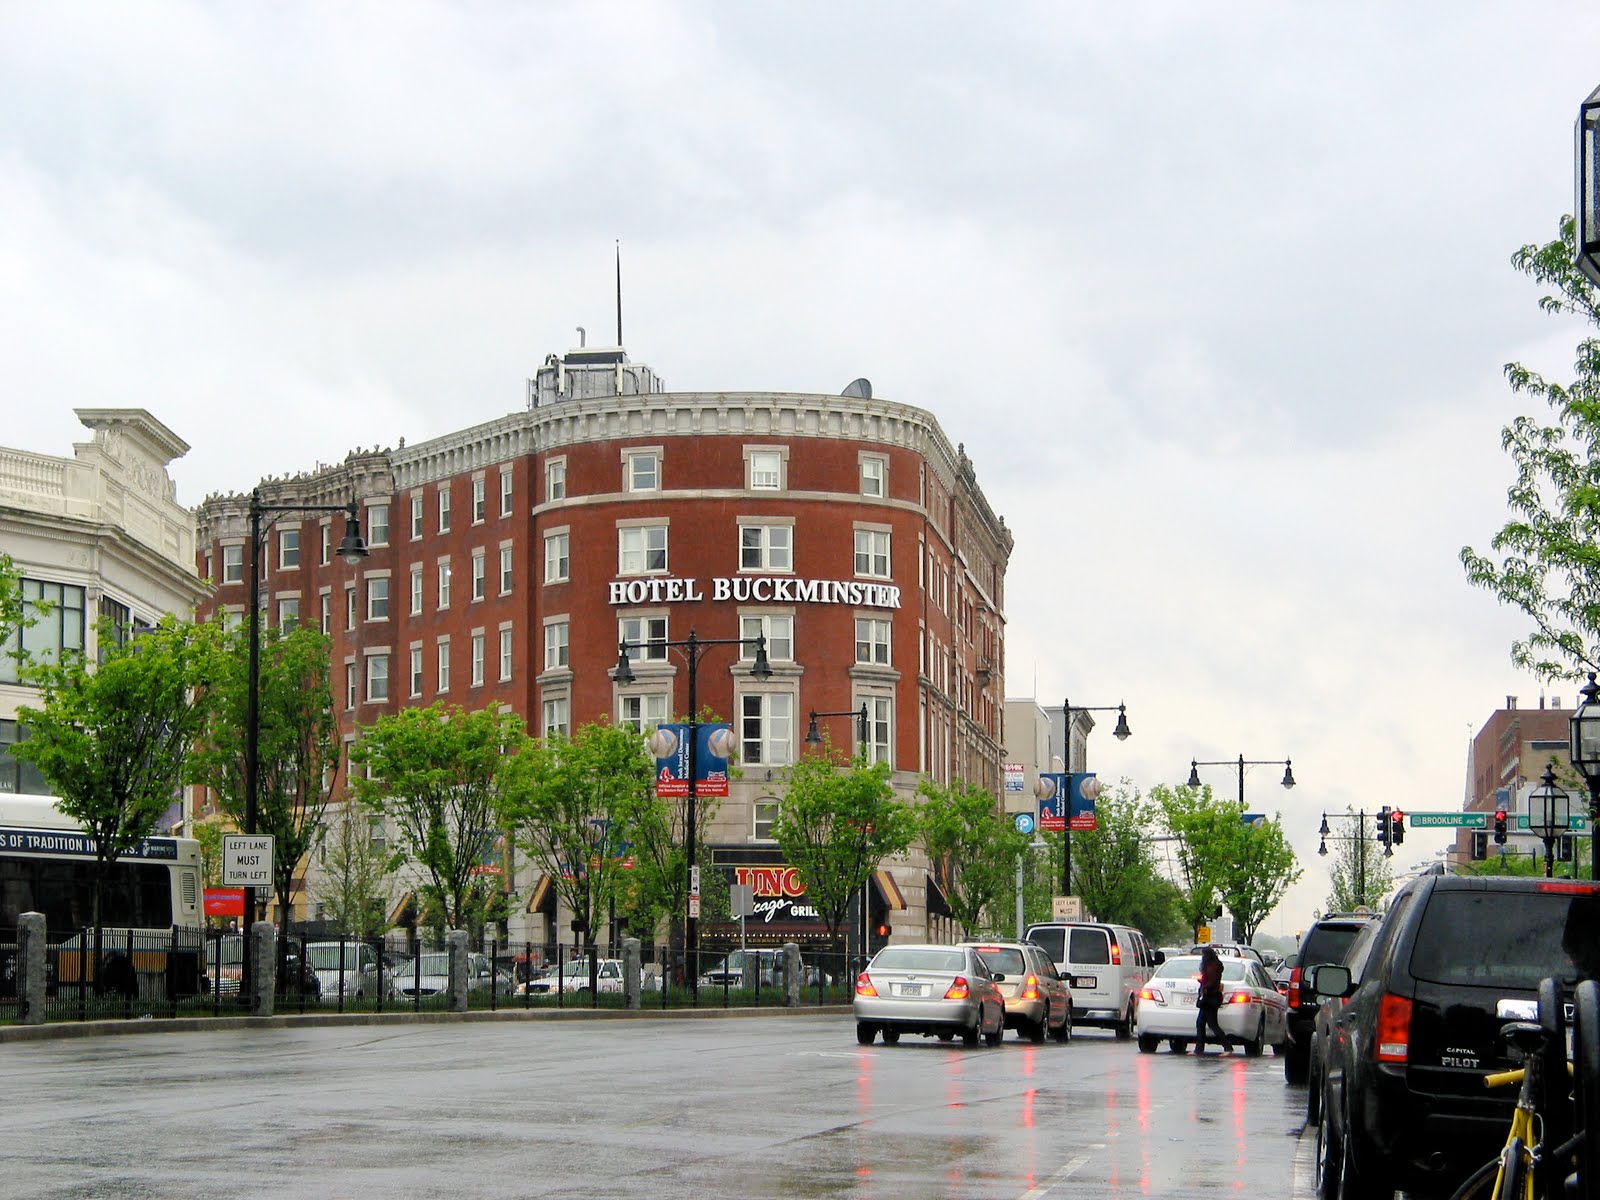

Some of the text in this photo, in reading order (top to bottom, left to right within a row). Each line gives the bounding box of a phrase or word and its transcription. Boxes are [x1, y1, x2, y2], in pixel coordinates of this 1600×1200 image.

[608, 577, 902, 609] HOTEL BUCKMINSTER
[1422, 816, 1463, 825] BROOKLINE
[10, 835, 23, 848] OF
[26, 835, 83, 851] TRADITION
[86, 840, 97, 852] IN
[237, 856, 260, 865] MUST
[229, 871, 267, 879] TURN LEFT
[735, 867, 808, 897] UNO
[1446, 1047, 1476, 1055] CAPITAL
[1441, 1056, 1480, 1068] PILOT
